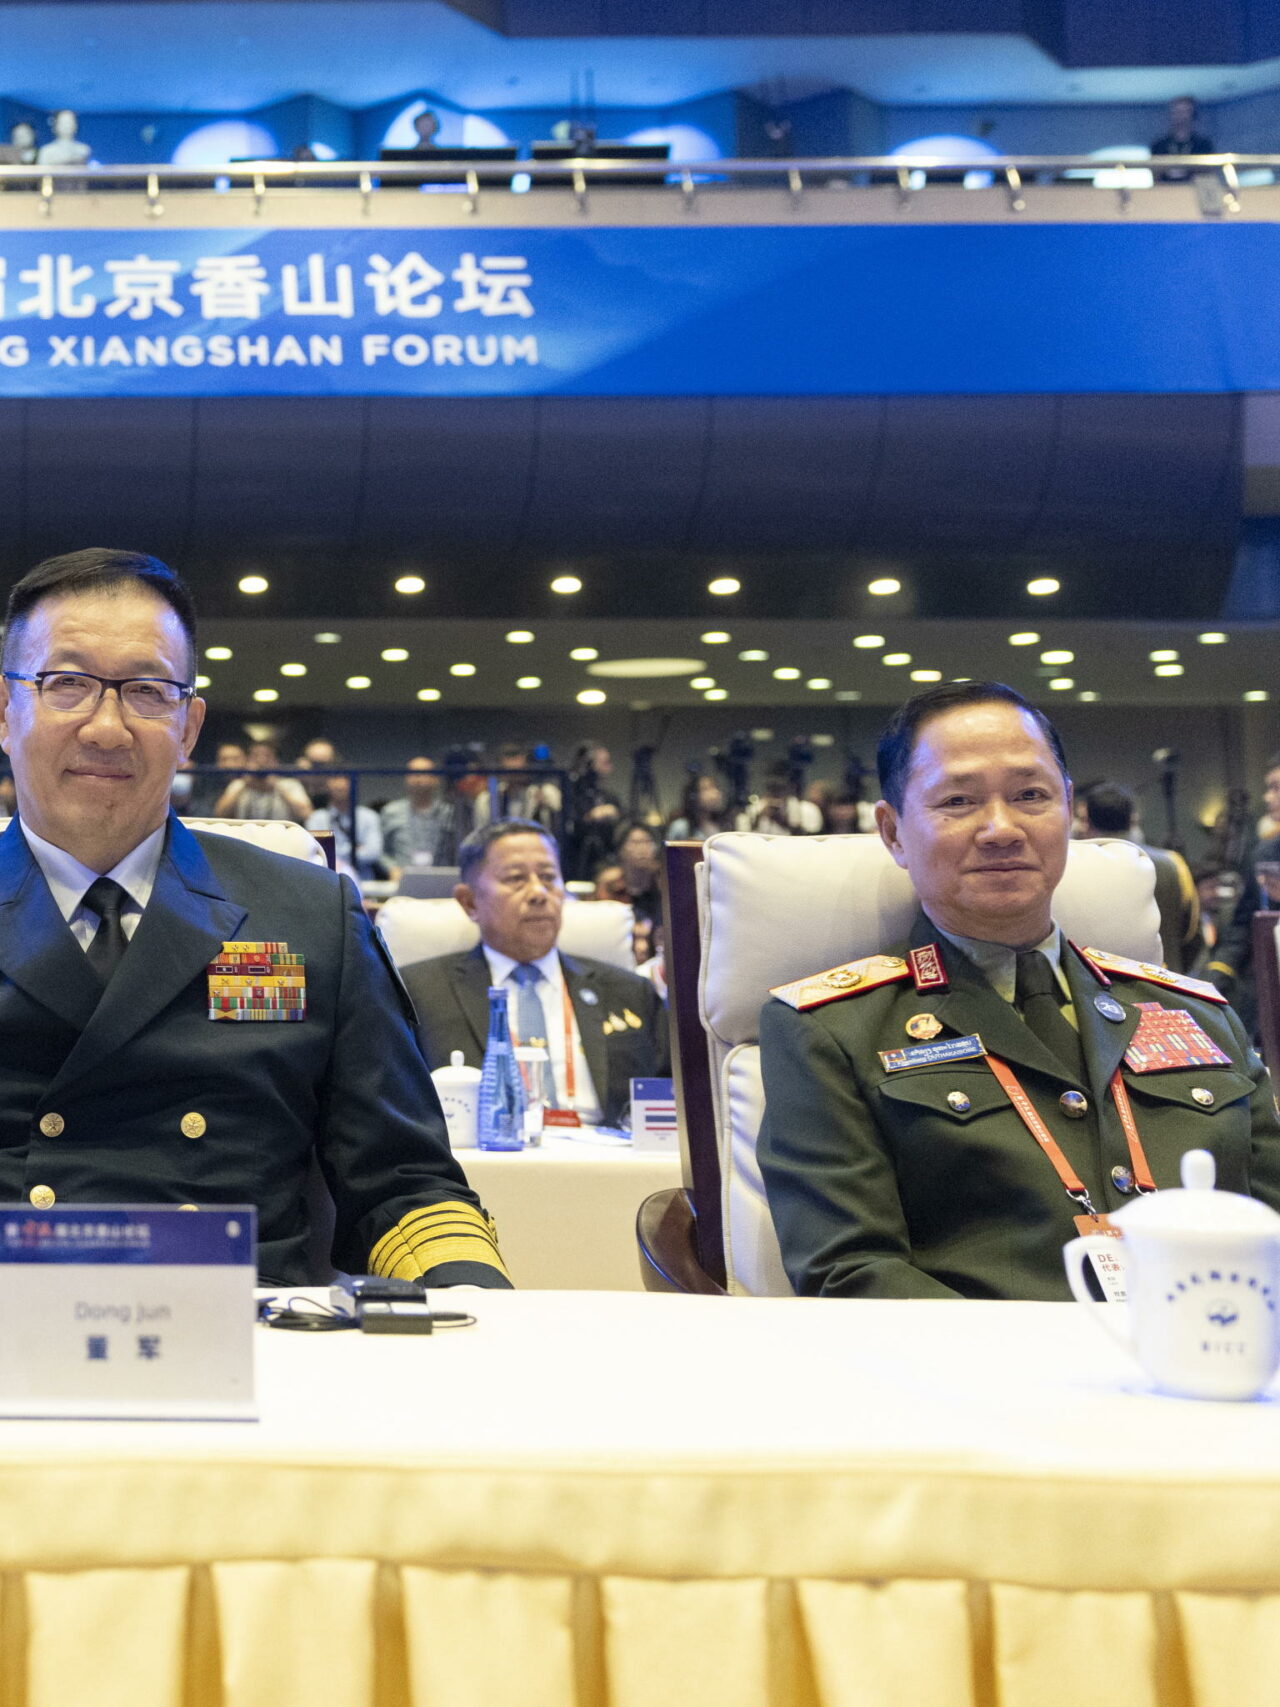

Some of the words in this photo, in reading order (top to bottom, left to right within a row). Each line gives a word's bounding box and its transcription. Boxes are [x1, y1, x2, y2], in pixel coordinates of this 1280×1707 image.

[48, 334, 343, 367] XIANGSHAN
[361, 333, 540, 366] FORUM
[74, 1301, 131, 1326] Dong
